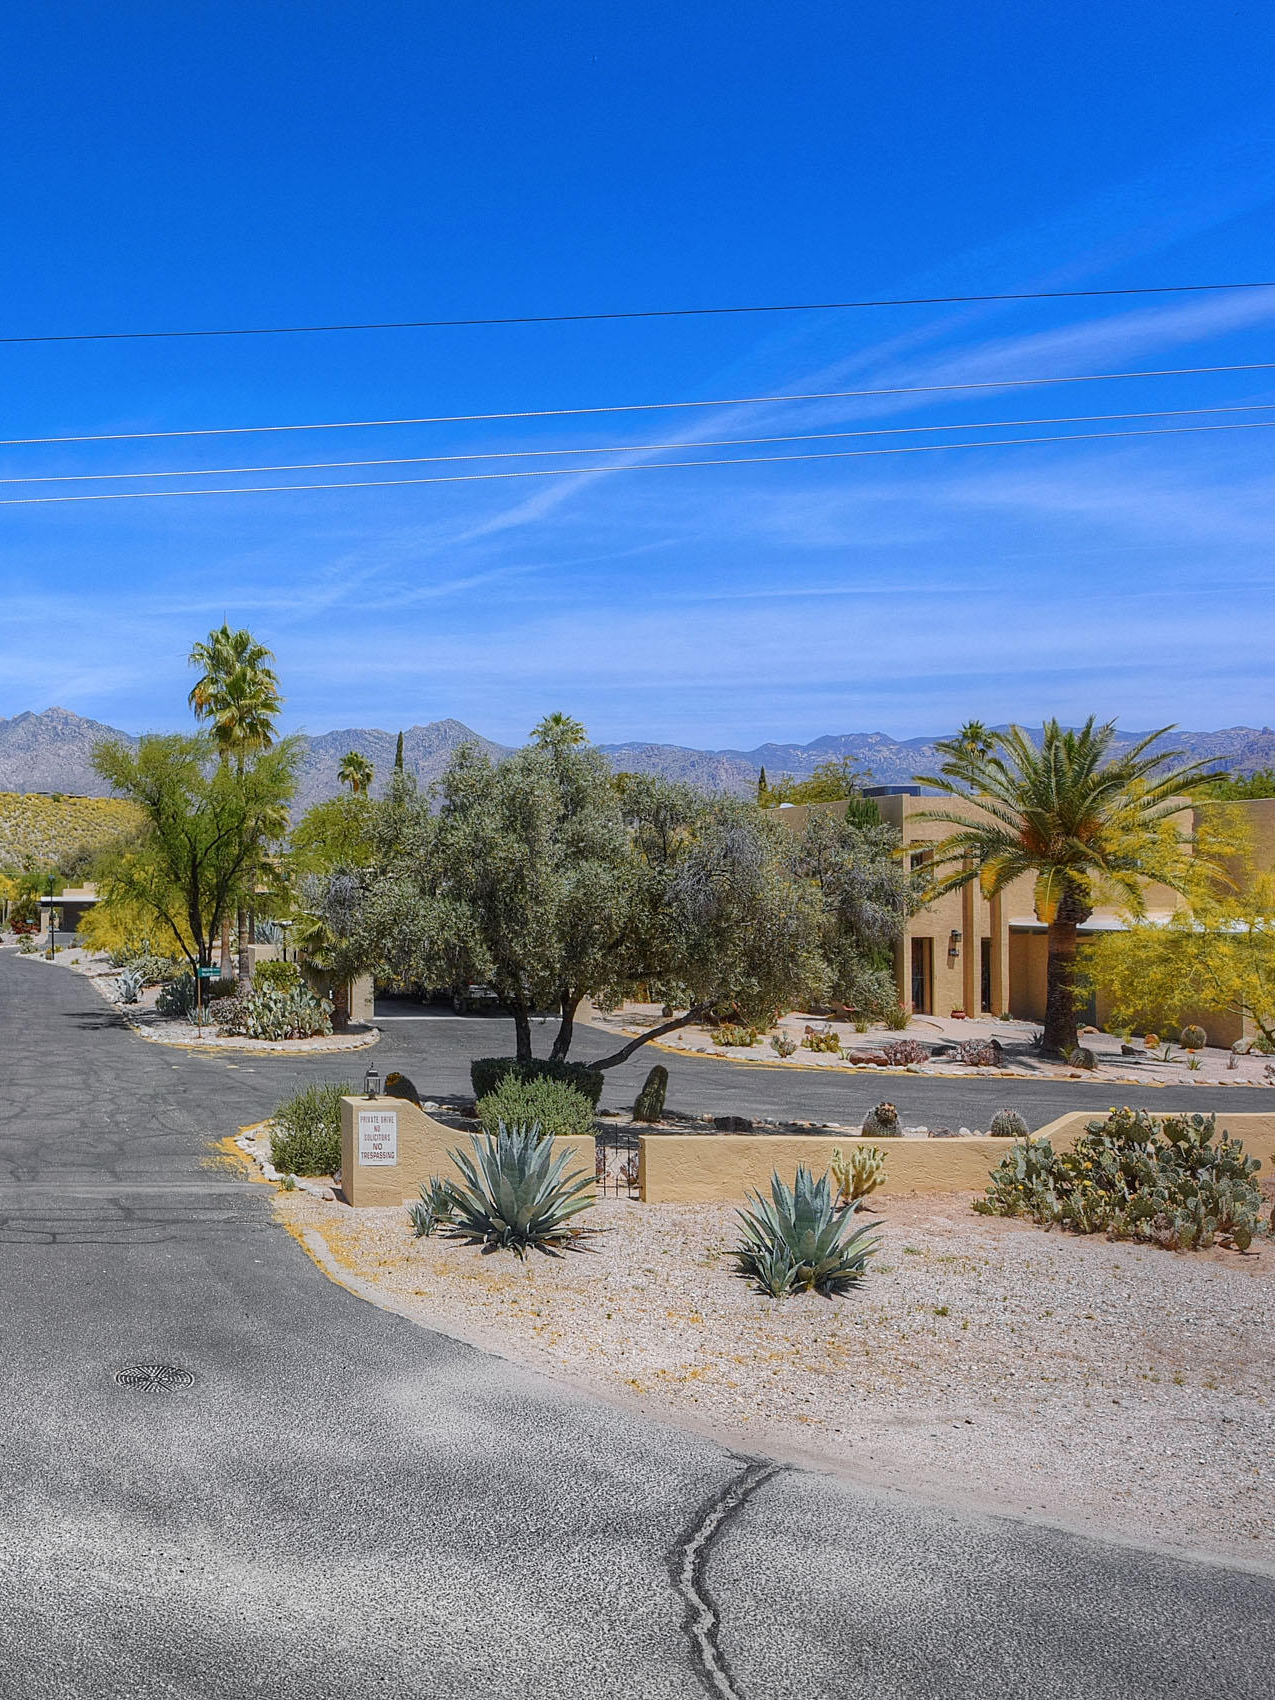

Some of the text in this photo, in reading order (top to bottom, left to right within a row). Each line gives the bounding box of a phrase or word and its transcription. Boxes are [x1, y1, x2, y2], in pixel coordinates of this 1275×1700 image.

[360, 1115, 395, 1124] PRIVATE DRIVE
[364, 1134, 391, 1142] SOLICITORS
[372, 1143, 383, 1151] NO
